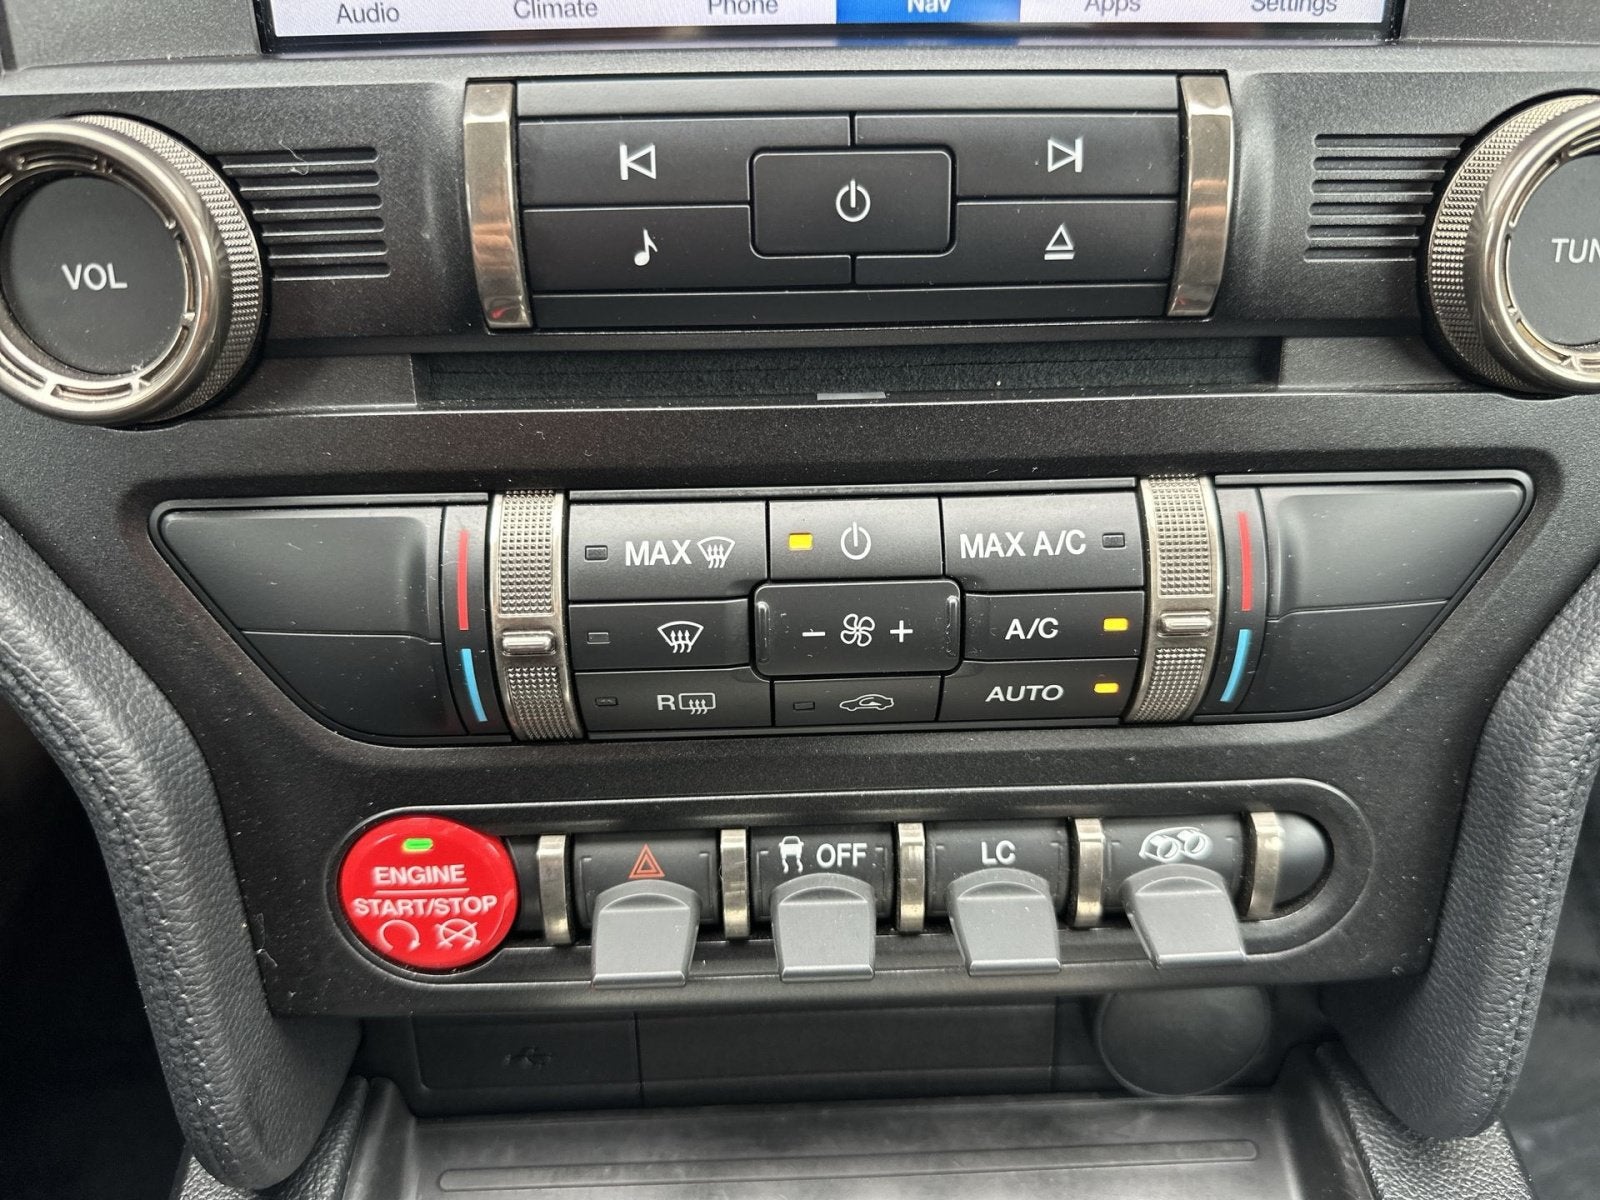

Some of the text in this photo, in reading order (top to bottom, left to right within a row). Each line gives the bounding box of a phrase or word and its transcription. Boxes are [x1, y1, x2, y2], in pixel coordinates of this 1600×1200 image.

[336, 3, 400, 24] Audio
[513, 0, 599, 19] Climate
[707, 0, 780, 15] Phone
[907, 0, 951, 14] Nav
[1084, 0, 1142, 16] Apps
[1250, 0, 1338, 16] Settings
[61, 262, 128, 291] VOL
[624, 540, 692, 567] MAX
[959, 529, 1087, 559] MAX A/C
[1004, 618, 1059, 641] A/C
[657, 694, 675, 711] R
[985, 684, 1064, 703] AUTO
[816, 843, 868, 867] OFF
[981, 840, 1017, 865] LC
[373, 864, 467, 886] ENGINE
[352, 895, 498, 918] START/STOP
